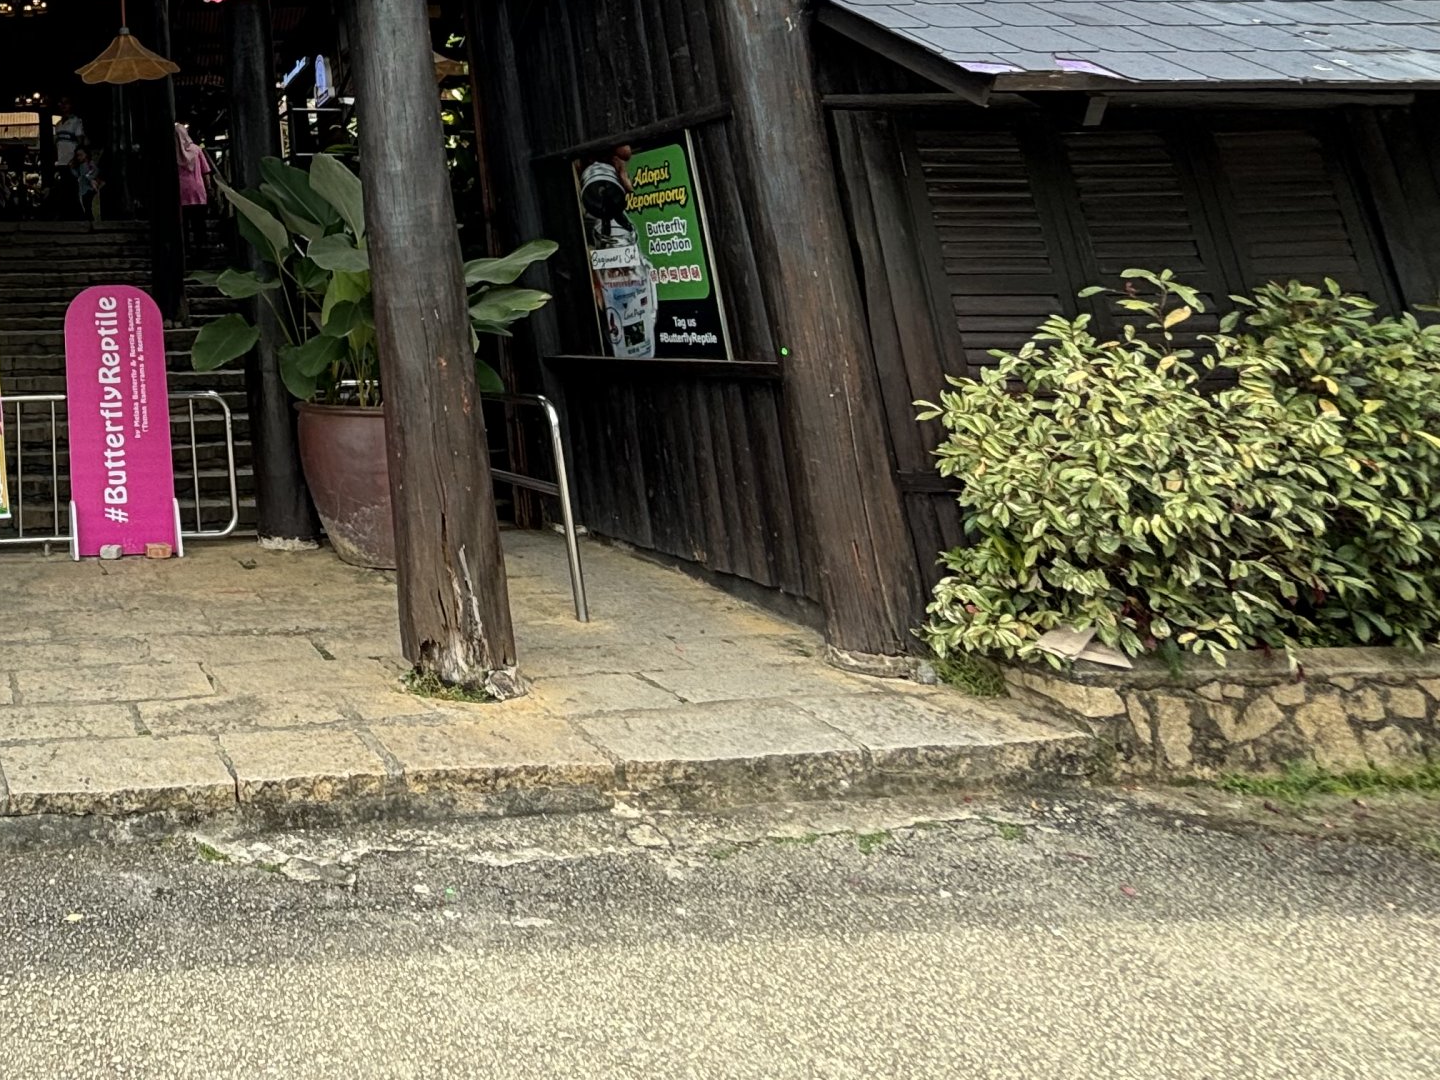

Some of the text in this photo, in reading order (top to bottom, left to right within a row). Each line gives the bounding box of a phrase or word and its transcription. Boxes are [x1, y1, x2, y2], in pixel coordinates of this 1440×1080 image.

[633, 162, 669, 187] Adopsi
[625, 186, 687, 211] Kepompong
[647, 220, 686, 236] Butterfly
[649, 238, 691, 254] Adoption
[673, 317, 697, 329] Tag us
[660, 332, 718, 346] #ButterflyReptile
[94, 296, 129, 524] #ButterflyReptile
[133, 401, 141, 428] Melaka
